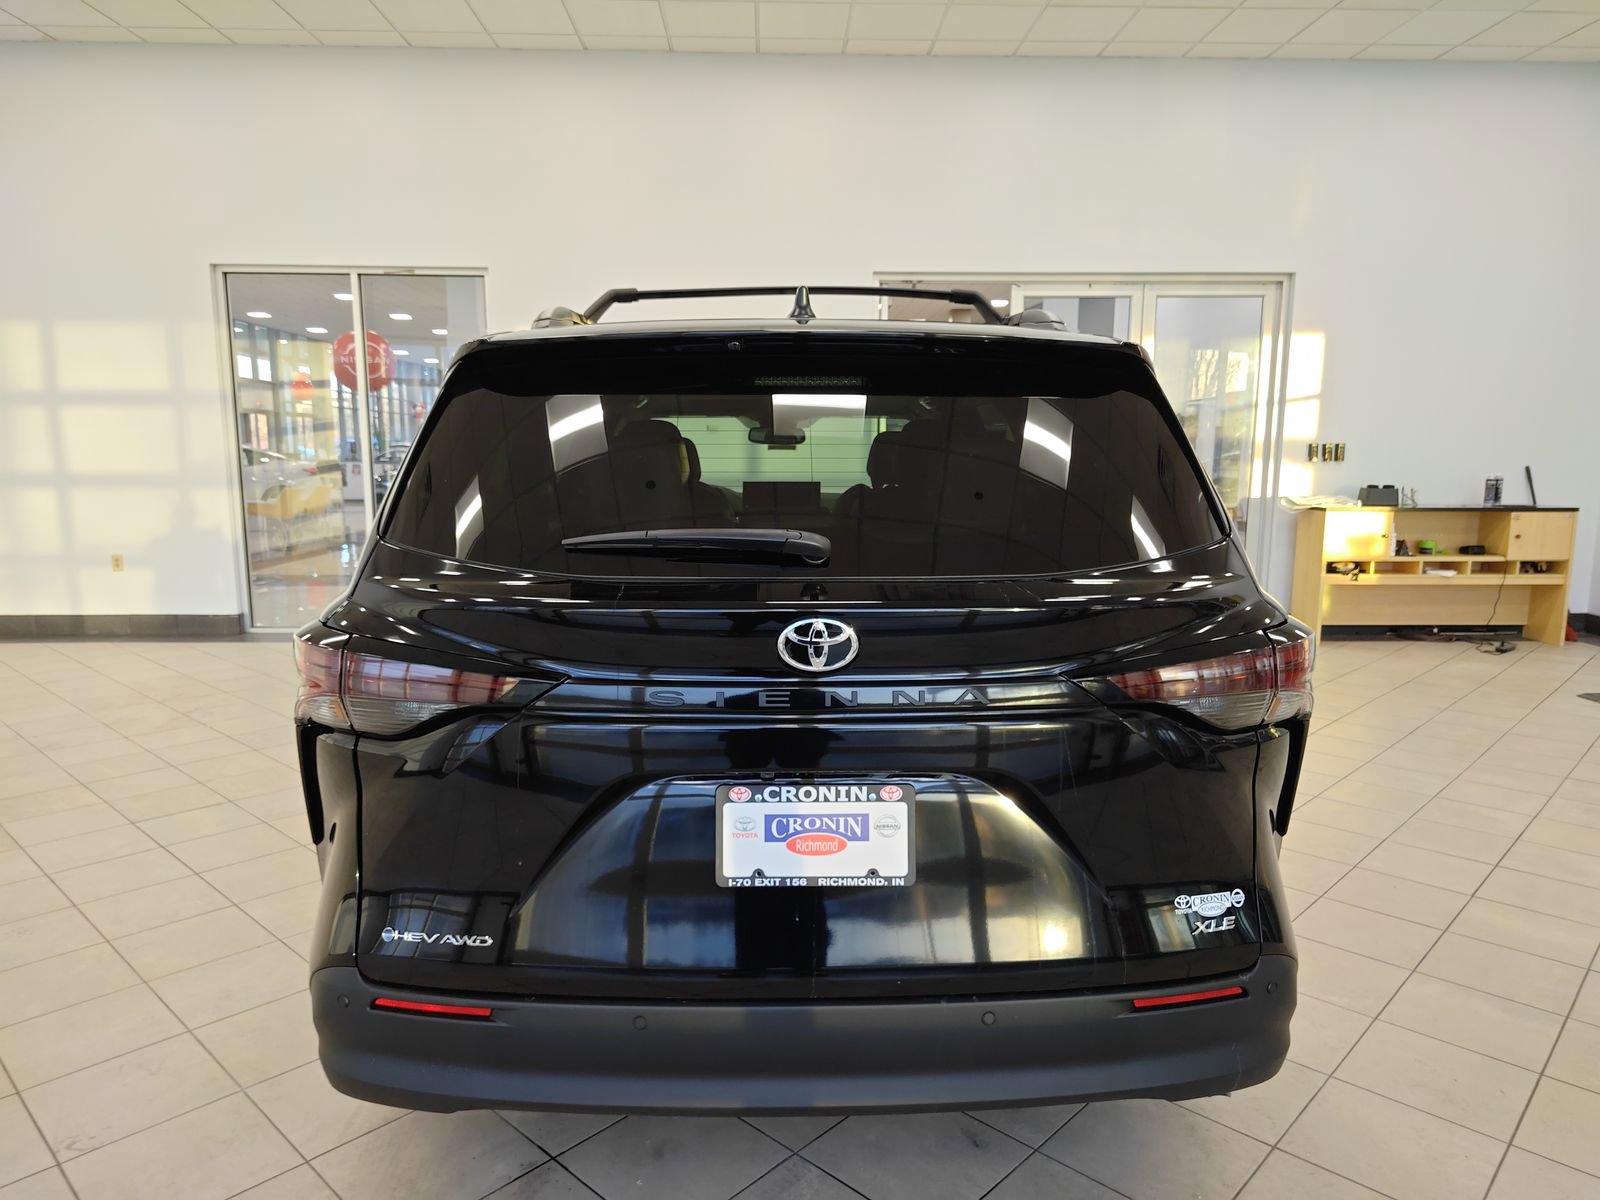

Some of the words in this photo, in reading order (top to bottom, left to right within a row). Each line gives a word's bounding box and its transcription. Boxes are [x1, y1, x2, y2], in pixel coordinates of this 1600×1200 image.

[649, 688, 990, 706] SIENNA
[763, 786, 867, 802] CRONIN
[771, 816, 862, 838] CRONIN
[795, 840, 838, 852] Richmond
[729, 878, 750, 886] I-70
[755, 878, 780, 886] EXIT
[786, 878, 807, 886] 156
[892, 877, 905, 886] IN
[1193, 893, 1230, 907] CRONIN
[1191, 916, 1236, 935] XLE
[394, 930, 440, 943] HEV
[440, 934, 493, 946] AWD
